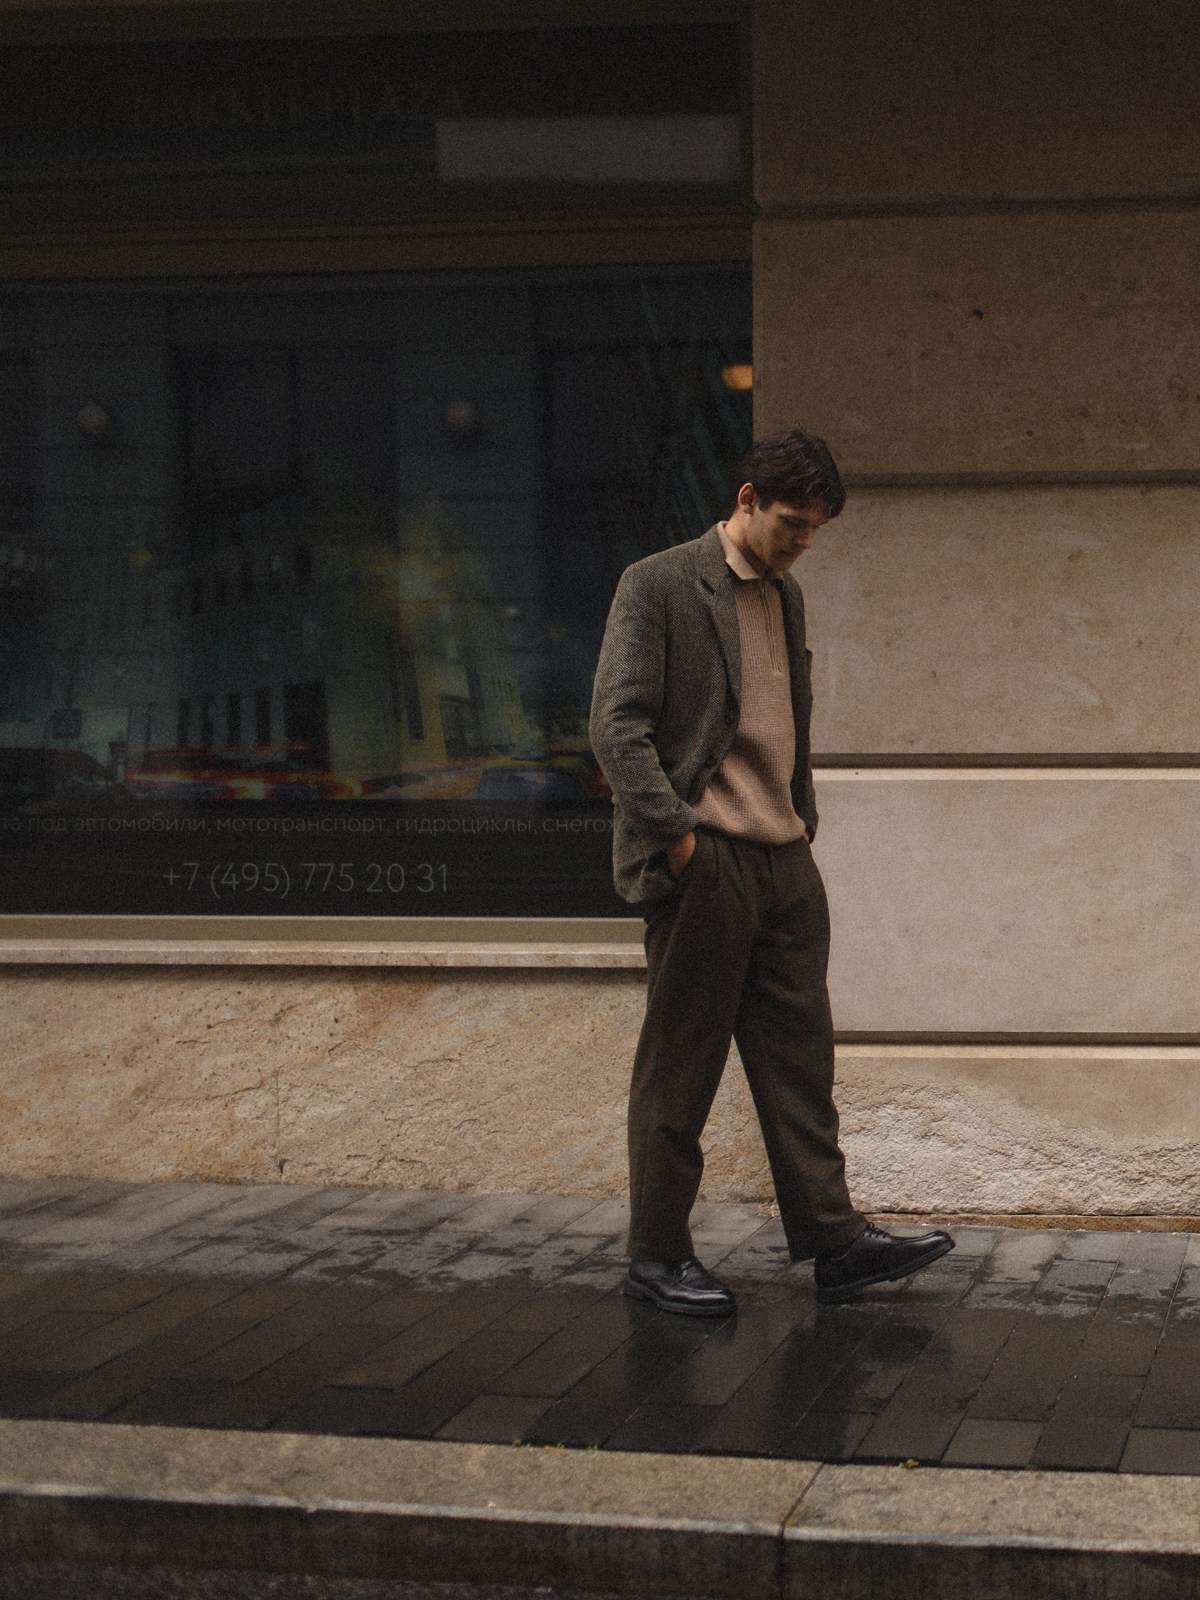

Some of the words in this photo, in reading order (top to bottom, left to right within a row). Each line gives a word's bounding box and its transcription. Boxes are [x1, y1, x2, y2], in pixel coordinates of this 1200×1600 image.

[73, 811, 212, 834] автомобили,
[216, 816, 391, 837] мототранспорт,
[396, 816, 539, 837] гидроциклы,
[162, 862, 200, 891] +7
[210, 862, 291, 900] (495)
[300, 862, 355, 892] 775
[365, 862, 406, 893] 20
[416, 862, 448, 893] 31
